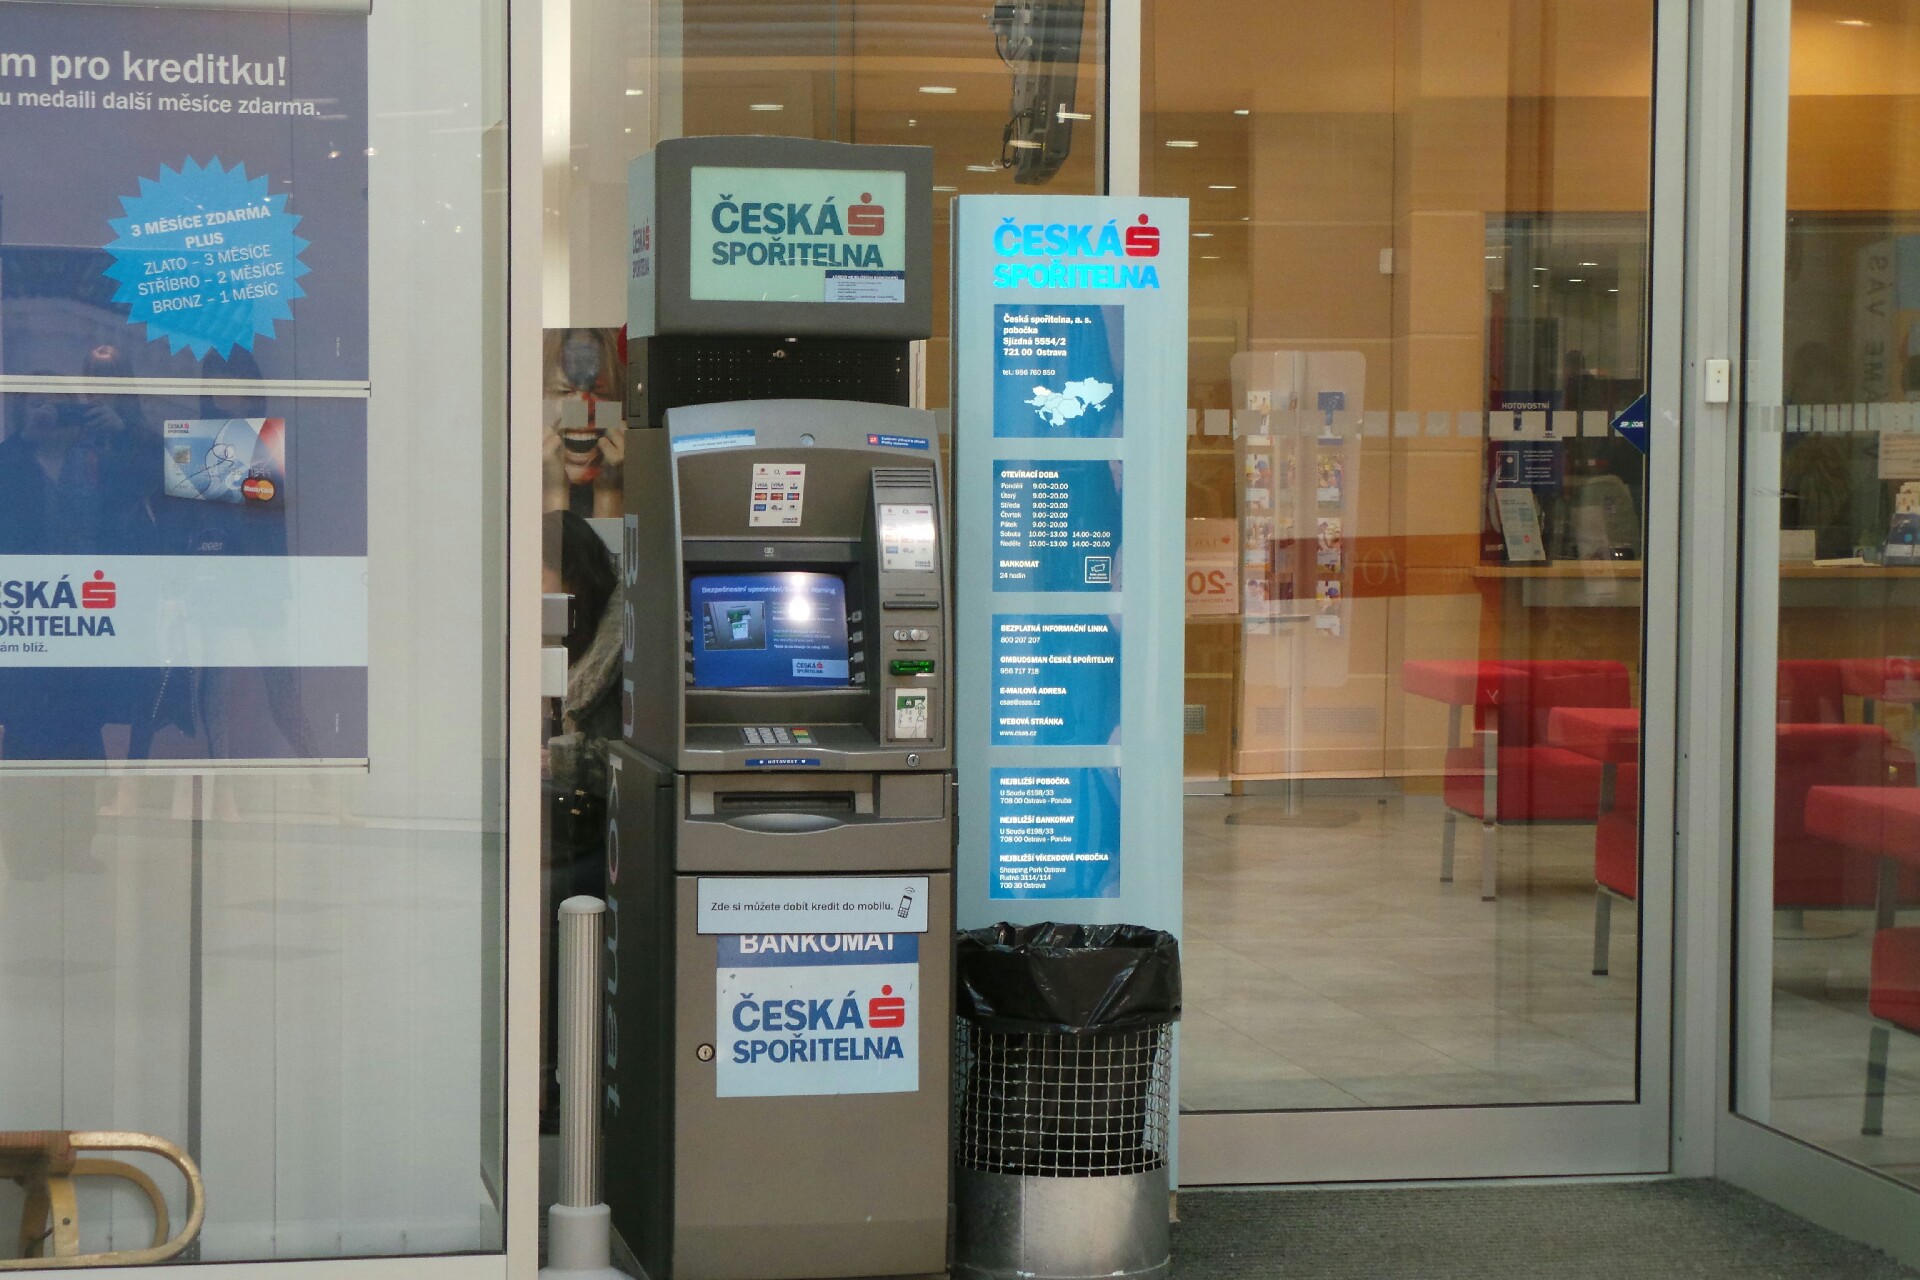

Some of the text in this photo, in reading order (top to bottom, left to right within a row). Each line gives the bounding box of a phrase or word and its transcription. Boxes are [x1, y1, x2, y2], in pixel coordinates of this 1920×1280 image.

[51, 54, 110, 86] pro
[123, 50, 287, 87] kreditku!
[18, 91, 95, 109] medaili
[102, 90, 151, 111] další
[158, 94, 231, 114] měsíce
[238, 97, 321, 117] zdarma.
[711, 194, 843, 235] ČESKÁ
[131, 205, 271, 238] 3 MĚSÍCE ZDARMA
[185, 232, 224, 250] PLUS
[992, 216, 1125, 258] ČESKÁ
[712, 236, 884, 268] SPOŘITELNA
[144, 257, 187, 276] ZLATO
[204, 253, 215, 266] 3
[217, 243, 273, 263] MĚSÍCE
[992, 257, 1161, 289] SPOŘITELNA
[138, 273, 201, 297] STŘÍBRO
[218, 271, 228, 284] 2
[230, 261, 285, 281] MĚSÍCE
[152, 294, 203, 314] BRONZ
[221, 291, 228, 303] 1
[232, 282, 279, 302] MĚSÍC
[1003, 313, 1029, 324] Česká
[1030, 314, 1074, 325] spořitelna,
[1003, 326, 1039, 336] pobočka
[1003, 337, 1067, 348] Sjízdná 5554/2
[1003, 348, 1067, 357] 721 00 Ostrava
[1502, 400, 1550, 410] HOTOVOSTNÍ
[1001, 470, 1038, 478] OTEVÍRACÍ
[1000, 482, 1023, 490] Pondělí
[1000, 560, 1040, 568] BANKOMAT
[1010, 571, 1026, 579] hodin
[0, 574, 78, 609] SKÁ
[1001, 624, 1041, 632] BEZPLATNÁ
[1042, 624, 1087, 632] INFORMAČNÍ
[23, 642, 48, 652] blíž.
[1000, 655, 1115, 664] OMBUDSMAN ČESKÉ SPOŘITELNY
[1000, 687, 1037, 695] E-MAILOVÁ
[1000, 717, 1064, 725] WEBOVÁ STRÁNKA
[1000, 777, 1070, 785] NEJBLIŽŠÍ POBOČKA
[1000, 816, 1075, 824] NEJBLIŽŠÍ BANKOMAT
[1000, 853, 1109, 862] NEJBLIŽŠÍ VÍKENDOVÁ POBOČKA
[1000, 866, 1028, 874] Shopping
[710, 901, 894, 911] Zde si můžete dobít kredit do mobilu.
[732, 991, 864, 1033] ČESKÁ
[732, 1032, 905, 1064] SPOŘITELNA
